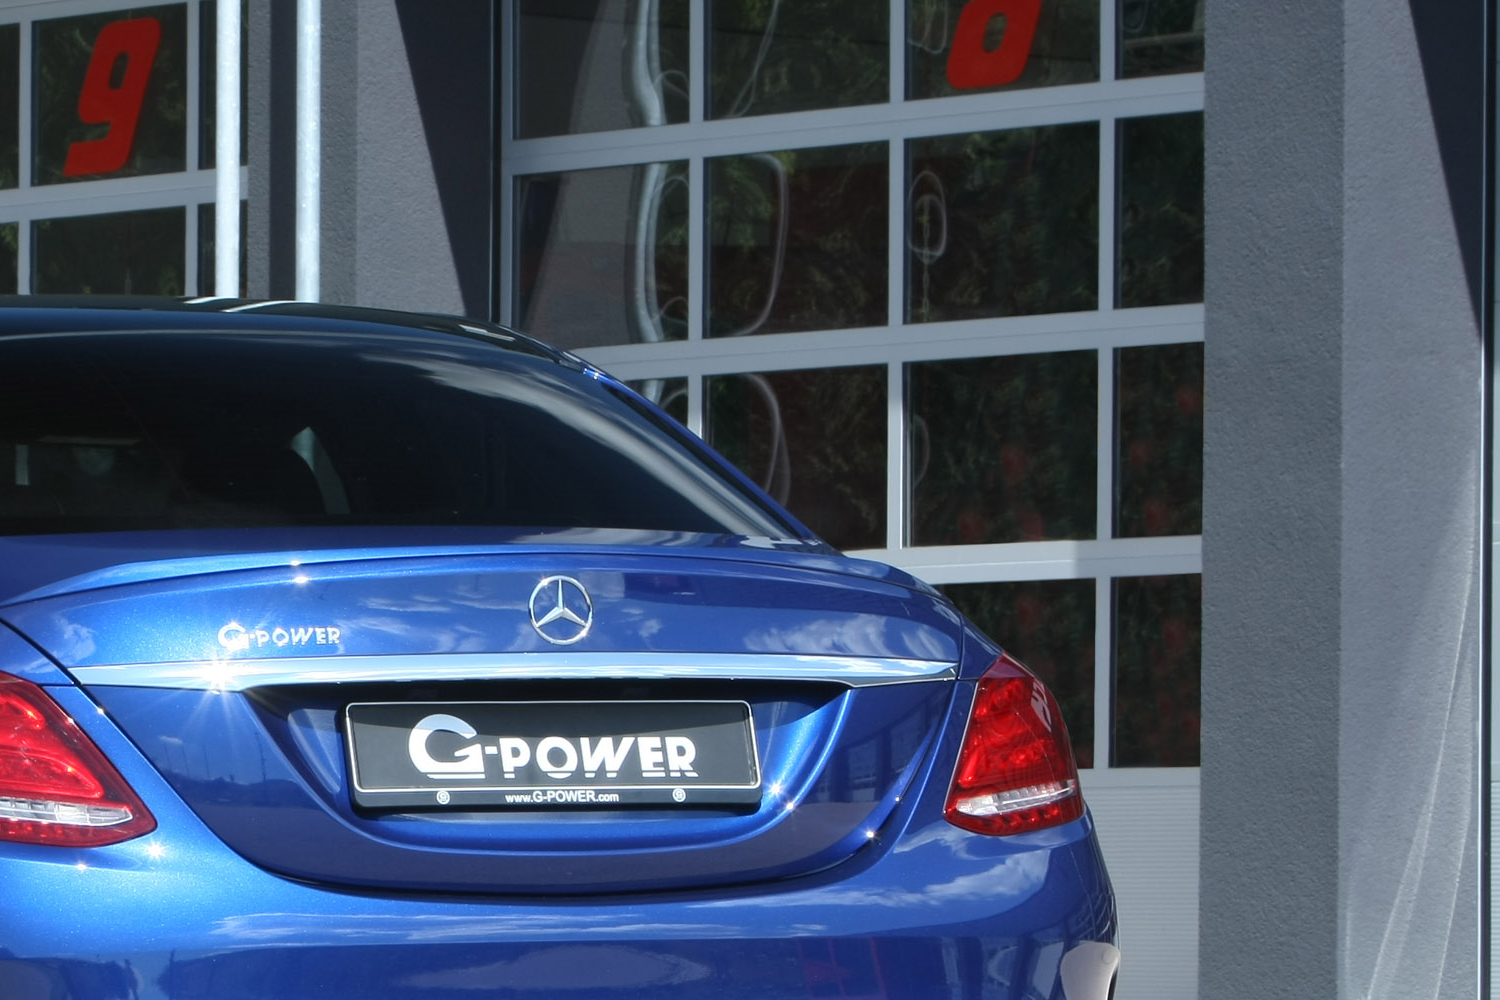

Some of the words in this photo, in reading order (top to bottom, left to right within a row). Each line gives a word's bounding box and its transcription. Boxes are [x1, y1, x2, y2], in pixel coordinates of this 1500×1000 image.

[63, 17, 161, 177] 9
[218, 621, 341, 650] G-POWER
[408, 713, 699, 780] G-POWER
[504, 790, 620, 803] www.G-POWER.com
